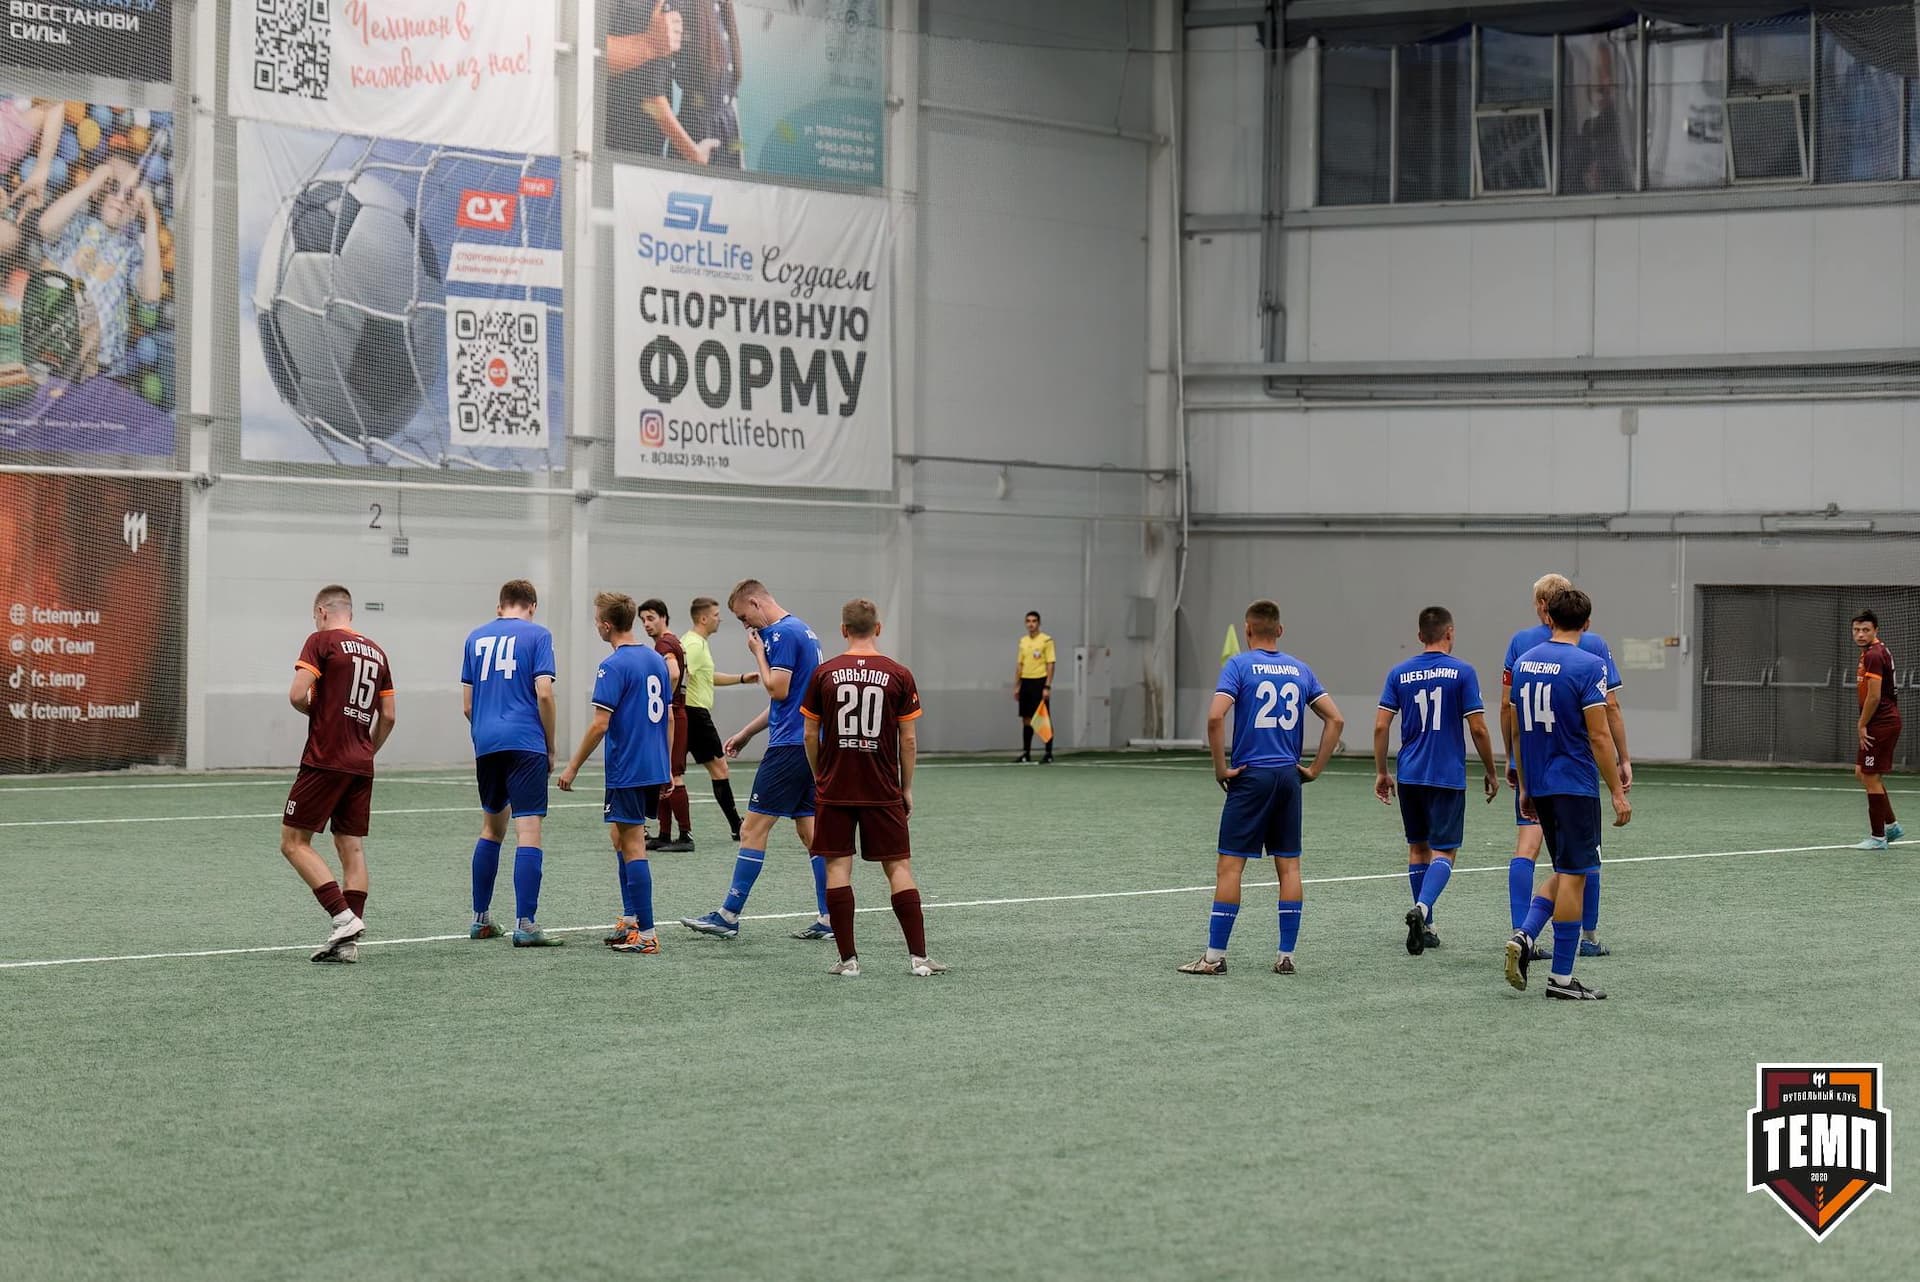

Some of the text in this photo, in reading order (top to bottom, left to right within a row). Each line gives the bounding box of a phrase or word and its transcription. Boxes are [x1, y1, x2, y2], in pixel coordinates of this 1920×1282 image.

[9, 1, 140, 32] ВОССТАНОВИ
[9, 21, 71, 45] СИЛЫ.
[344, 0, 451, 46] Чемпион
[350, 32, 533, 91] каждом из нас!
[664, 191, 729, 235] SL
[638, 232, 753, 271] SportLife
[761, 243, 876, 299] Создаем
[639, 286, 870, 342] СПОРТИВНУЮ
[639, 335, 867, 417] ФОРМУ
[668, 417, 805, 450] sportlifebrn
[369, 503, 382, 529] 2
[31, 606, 100, 628] fctemp.ru
[31, 637, 95, 654] ФК Темп
[475, 635, 517, 681] 74
[31, 669, 86, 691] fc.temp
[349, 656, 379, 710] 15
[832, 668, 890, 686] ЗАВЬЯЛОВ
[1400, 667, 1458, 684] ЩЕБЛЫКИН
[1520, 661, 1561, 675] ТИЩЕНКО
[31, 701, 140, 722] fctemp_barnaul
[647, 675, 664, 723] 8
[837, 684, 884, 738] 20
[1254, 680, 1300, 730] 23
[1414, 686, 1442, 732] 11
[1520, 682, 1555, 732] 14
[839, 739, 878, 750] SEUS
[286, 799, 297, 815] 15
